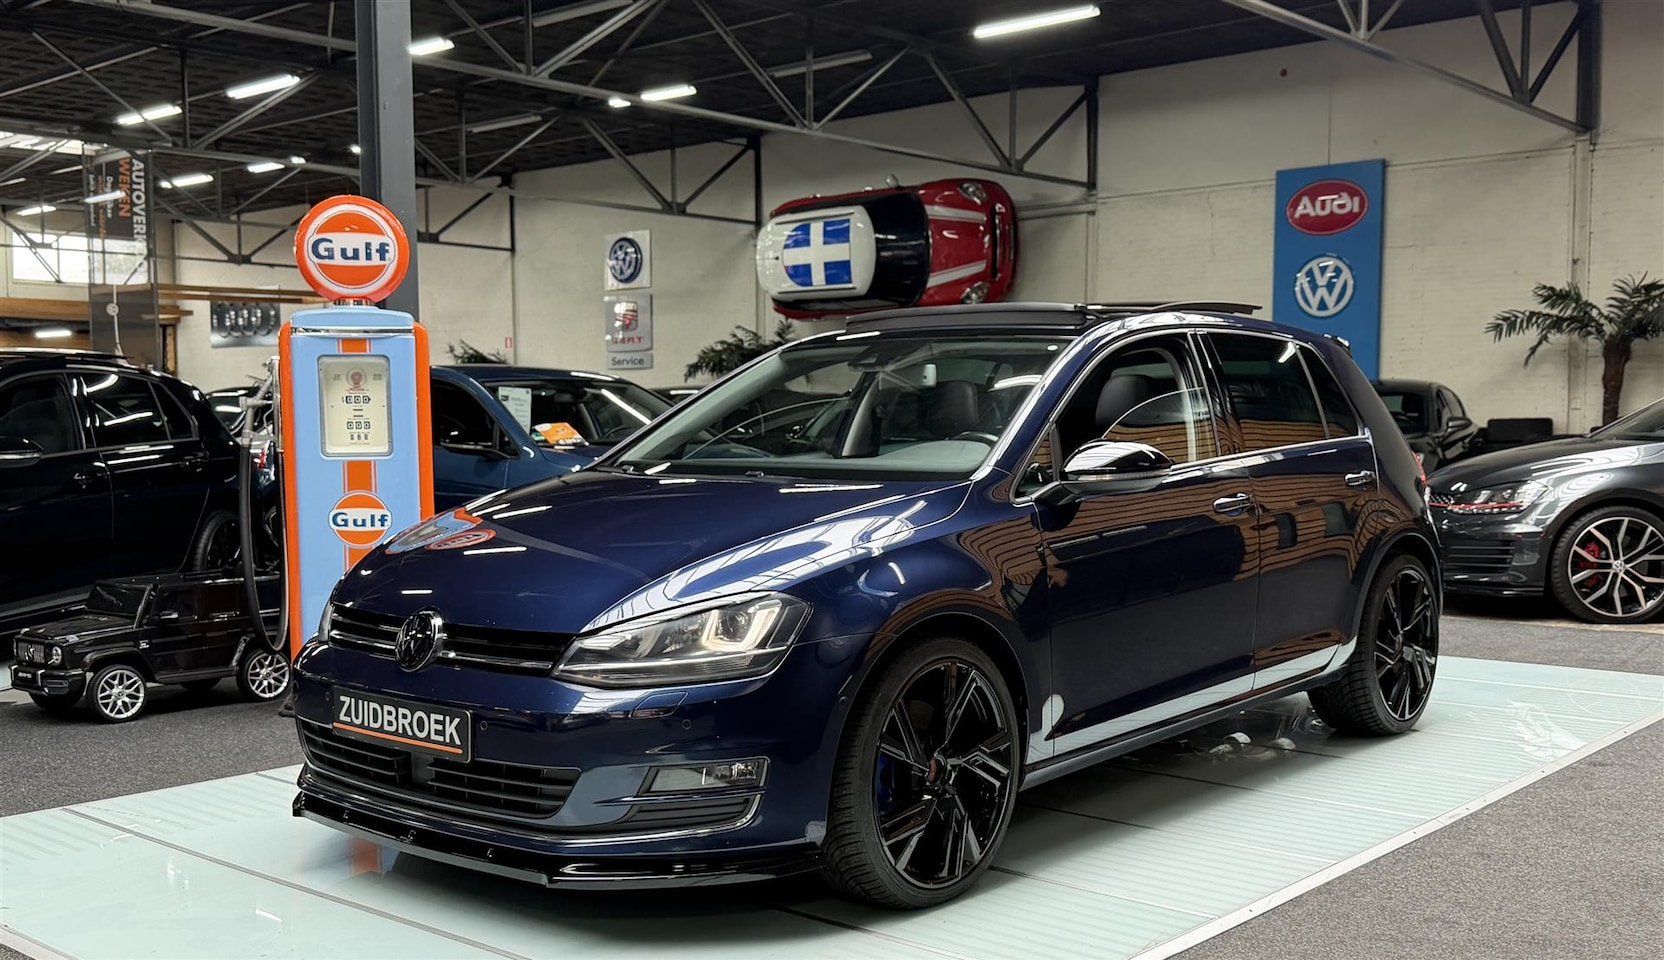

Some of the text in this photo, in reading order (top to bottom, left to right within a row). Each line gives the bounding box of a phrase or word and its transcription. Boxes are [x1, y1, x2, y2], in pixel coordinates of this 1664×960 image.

[119, 157, 131, 217] WEKEN
[311, 237, 390, 262] Gulf
[612, 356, 645, 366] Service
[332, 512, 389, 528] Gulf
[339, 695, 461, 745] ZUIDBROEK
